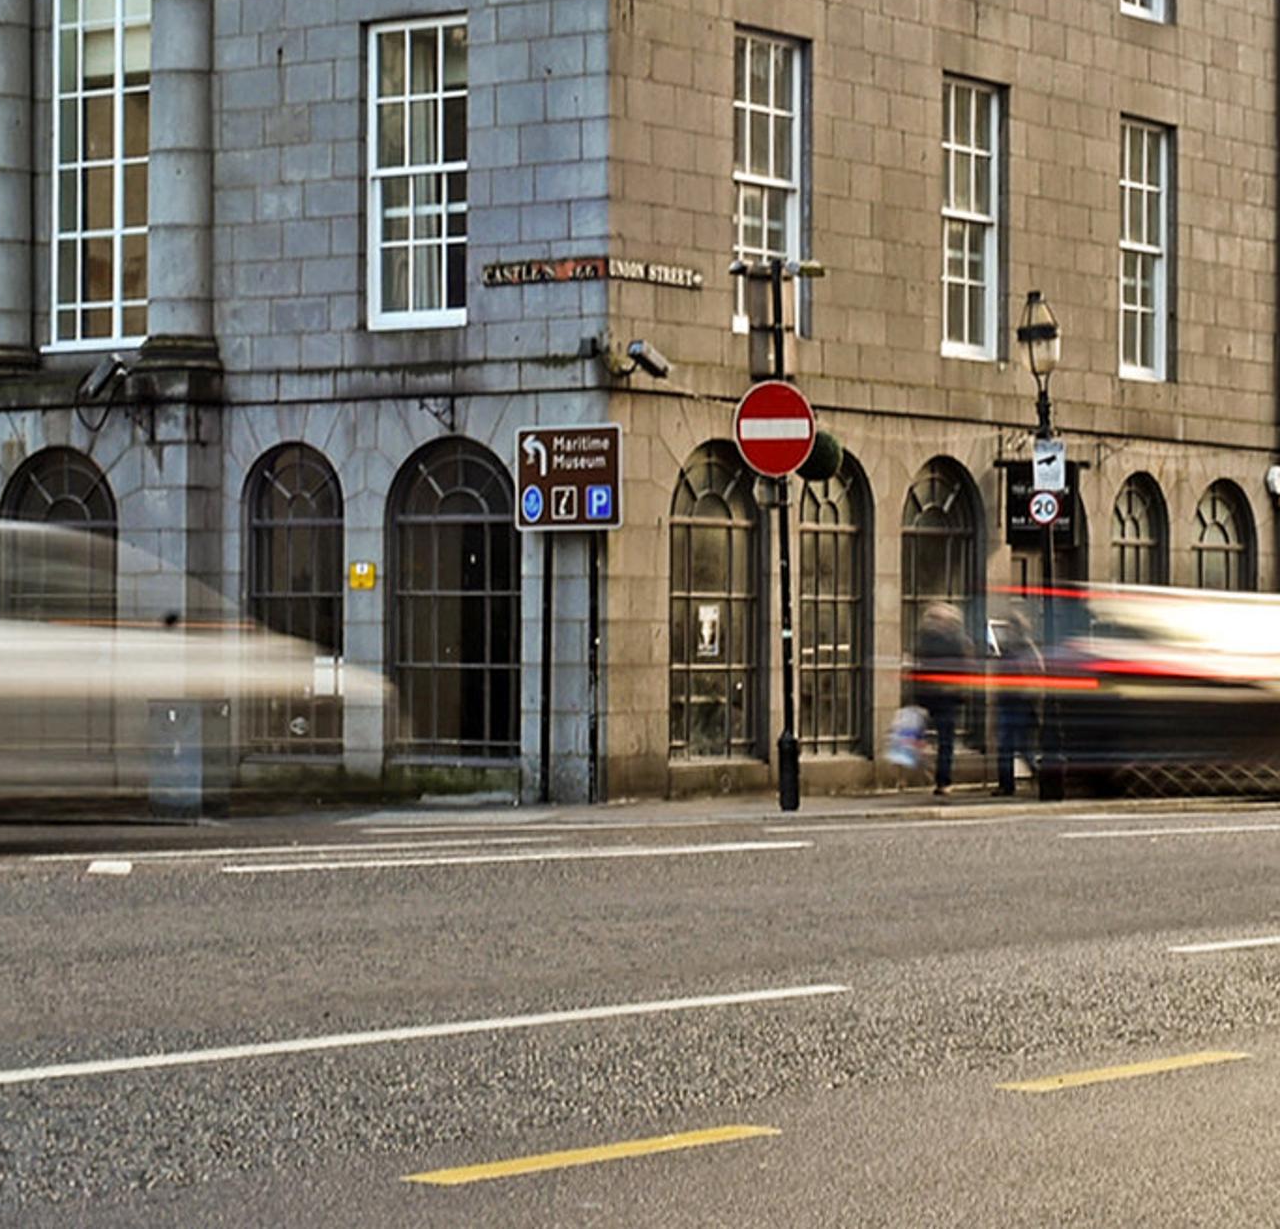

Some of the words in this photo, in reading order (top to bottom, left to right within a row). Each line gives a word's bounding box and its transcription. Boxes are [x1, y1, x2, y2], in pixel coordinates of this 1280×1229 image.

[609, 258, 645, 278] UNION
[648, 263, 692, 286] STREET
[552, 436, 610, 452] Maritime
[552, 454, 607, 470] Museum
[591, 489, 608, 516] P
[1033, 499, 1056, 516] 20
